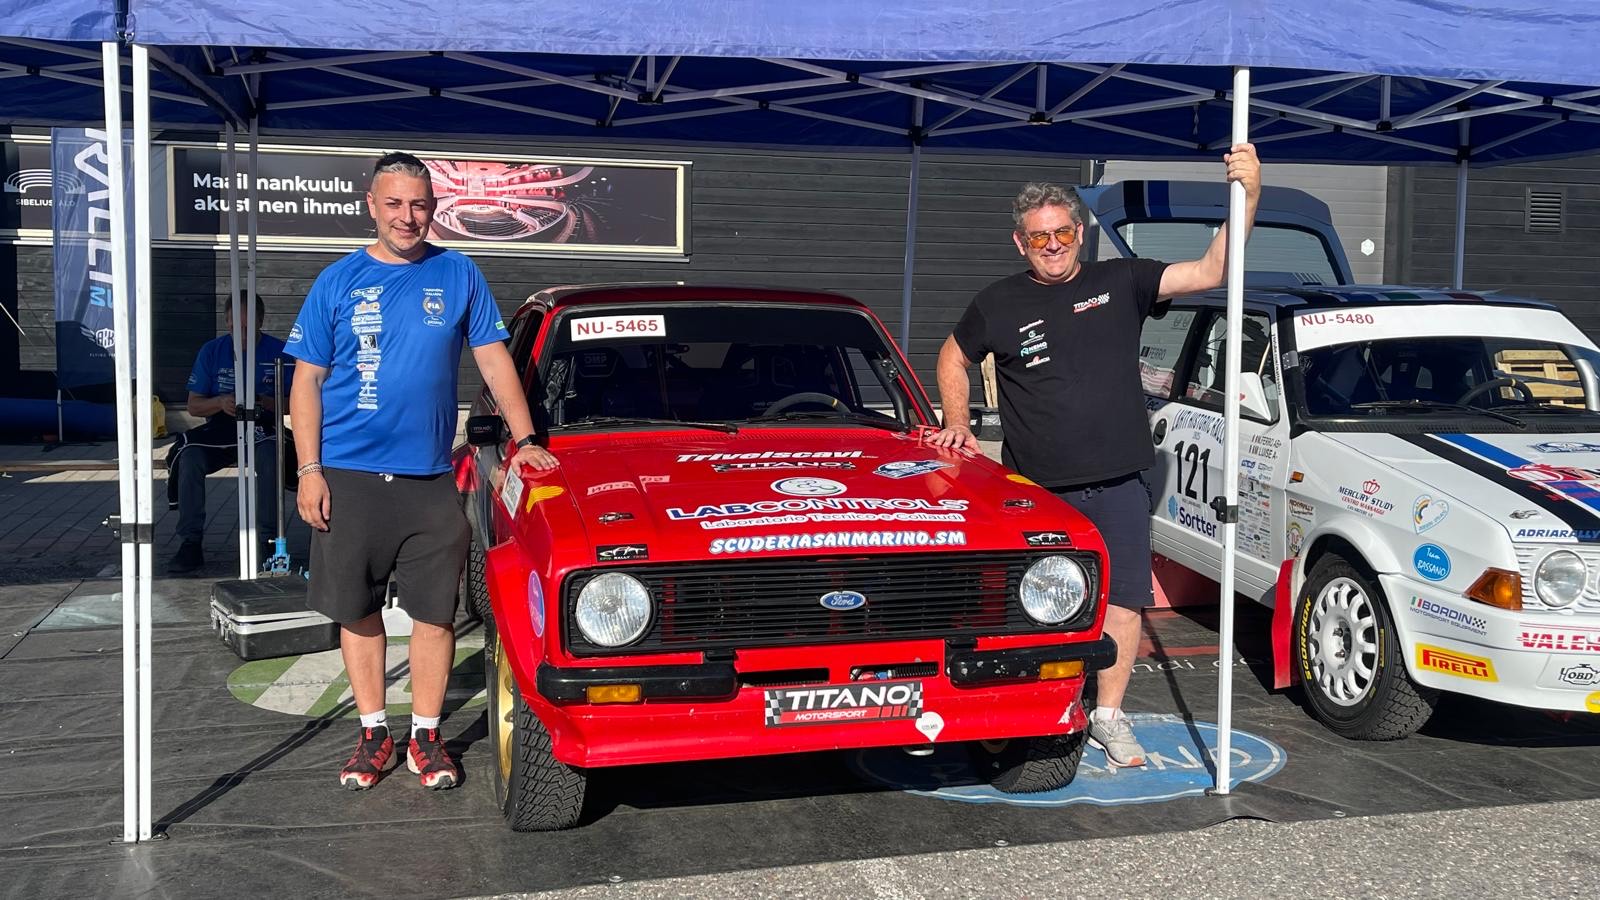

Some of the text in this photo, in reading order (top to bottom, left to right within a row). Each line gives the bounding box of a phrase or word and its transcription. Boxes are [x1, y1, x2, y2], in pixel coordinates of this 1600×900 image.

[194, 195, 361, 215] akustnen ihme!
[427, 302, 440, 310] FIA
[577, 319, 658, 335] NU-5465
[1300, 313, 1375, 327] NU-5480
[1174, 440, 1211, 504] 121
[668, 498, 969, 519] LABCONTROLS
[1339, 486, 1394, 512] MERCURY STUDY
[703, 515, 807, 529] Laboratorio
[811, 512, 877, 521] Tecnico
[895, 512, 964, 521] Collaudi
[1179, 507, 1217, 537] Sortter
[709, 531, 966, 554] SCUDERIASANMARINO.SM
[1417, 559, 1446, 577] BASSANO
[830, 594, 855, 606] Ford
[1409, 607, 1450, 626] MOTORSPORT
[1421, 601, 1473, 625] BORDIN
[1300, 595, 1313, 681] SCORPION
[1422, 648, 1489, 678] PIRELLI
[1567, 671, 1594, 681] OBD
[786, 685, 912, 711] TITANO
[794, 709, 867, 721] MOTORSPORT
